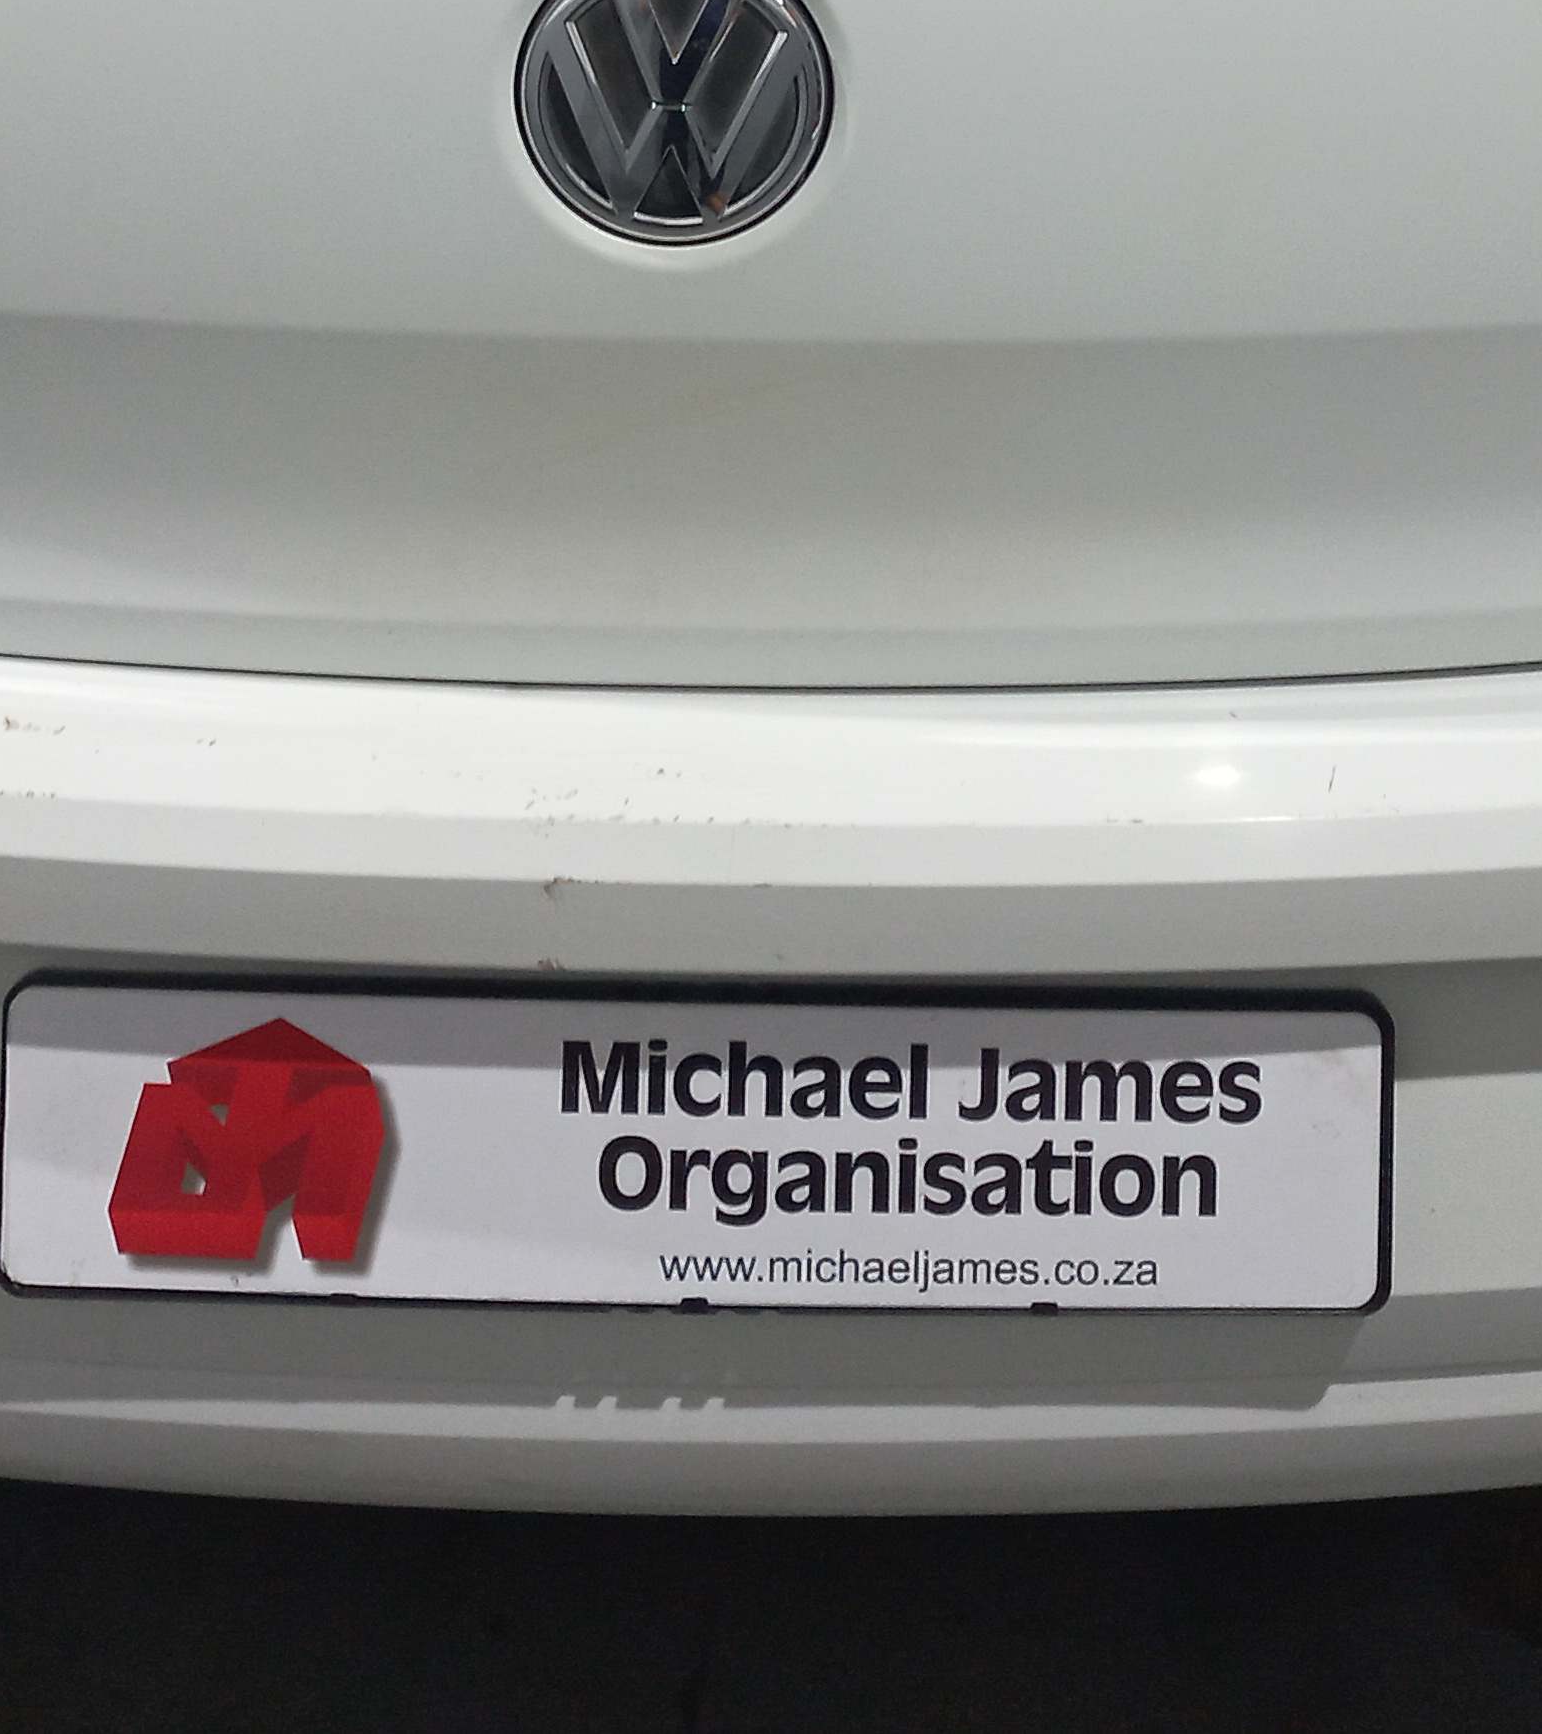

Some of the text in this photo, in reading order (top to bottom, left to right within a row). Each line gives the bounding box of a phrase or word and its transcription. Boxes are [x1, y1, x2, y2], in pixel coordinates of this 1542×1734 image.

[560, 1038, 1263, 1124] Michael James
[597, 1134, 1219, 1227] Organisation
[658, 1248, 1160, 1293] www.michaeljames.co.za
